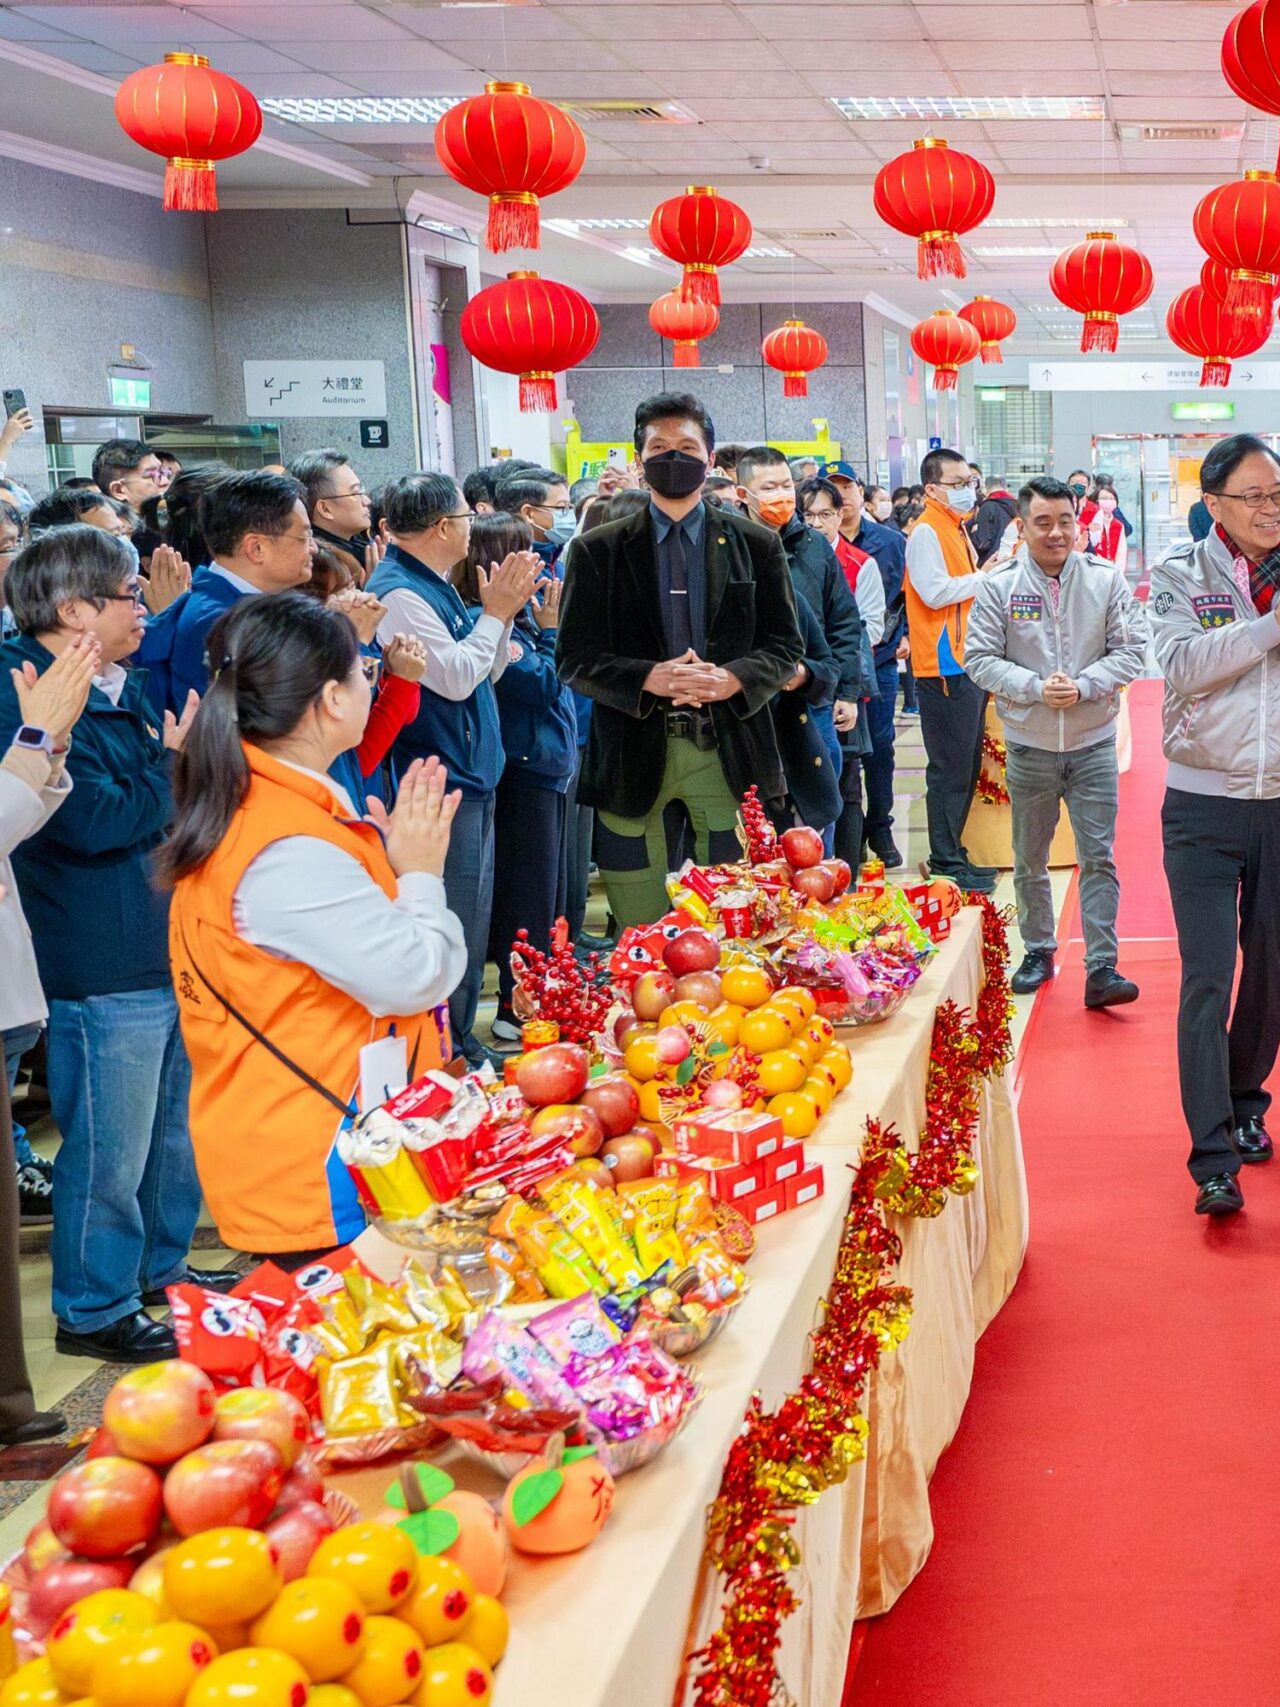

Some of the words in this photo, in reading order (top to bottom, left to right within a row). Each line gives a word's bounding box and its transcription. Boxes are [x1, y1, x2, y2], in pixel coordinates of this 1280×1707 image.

[322, 377, 364, 391] 大禮堂
[322, 396, 366, 404] Auditorium
